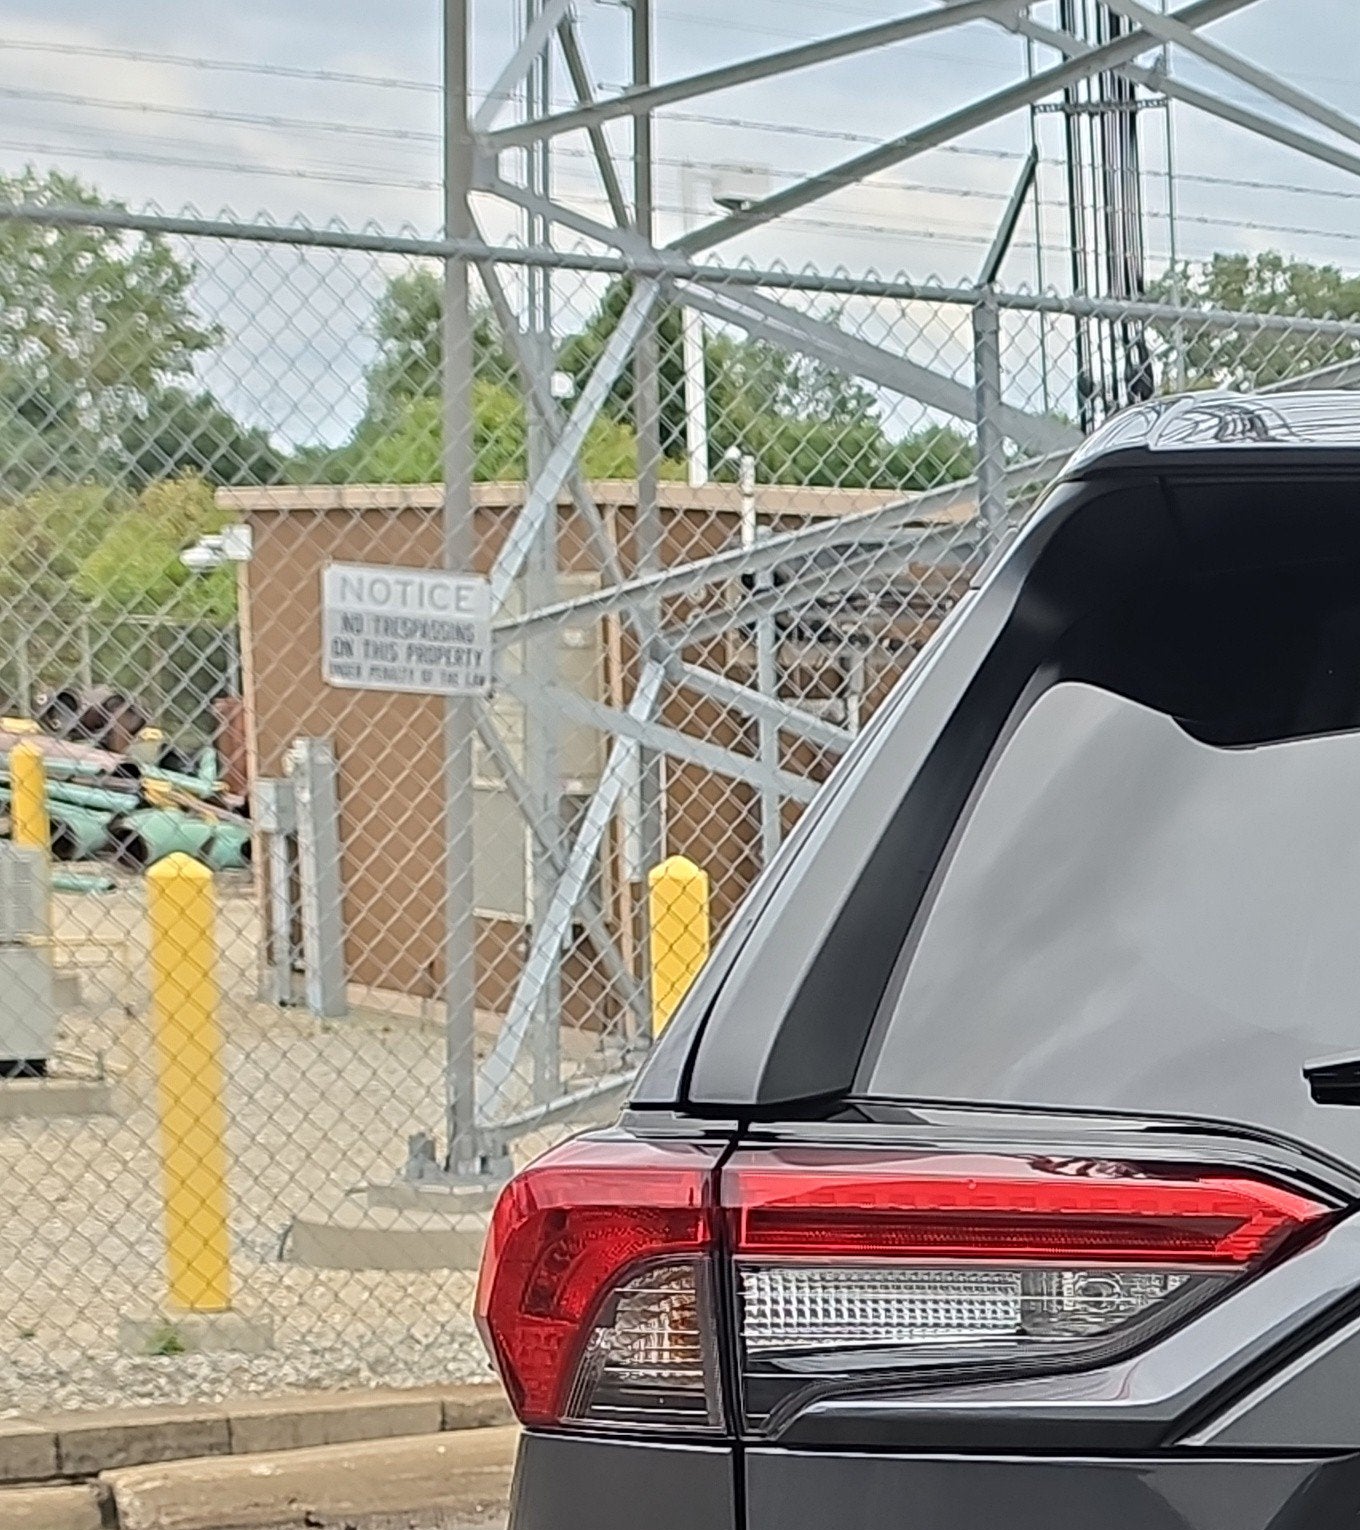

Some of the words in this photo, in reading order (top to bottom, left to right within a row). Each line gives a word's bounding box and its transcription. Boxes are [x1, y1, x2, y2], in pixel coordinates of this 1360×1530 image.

[339, 576, 475, 612] NOTICE
[341, 612, 364, 634] NO
[373, 614, 475, 643] TRESPASSING
[331, 636, 354, 658] ON
[363, 639, 398, 662] THIS
[406, 642, 483, 668] PROPERTY
